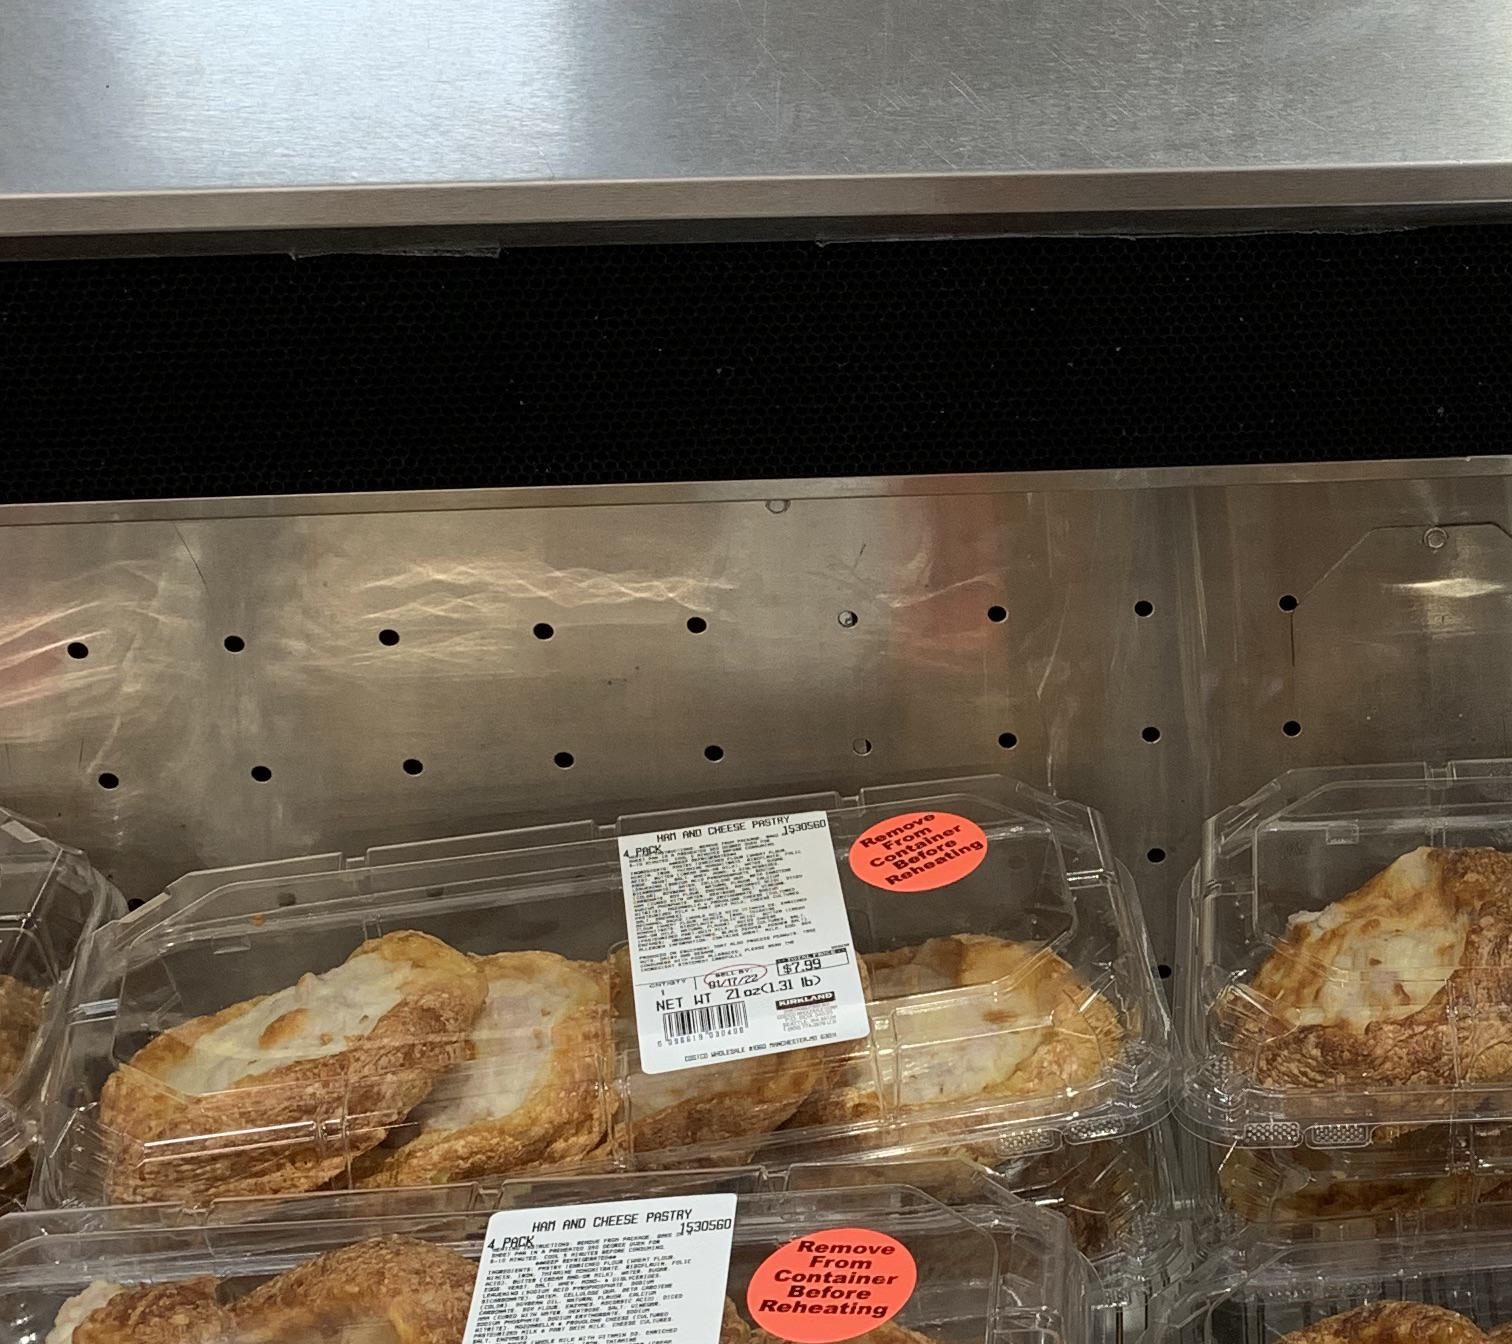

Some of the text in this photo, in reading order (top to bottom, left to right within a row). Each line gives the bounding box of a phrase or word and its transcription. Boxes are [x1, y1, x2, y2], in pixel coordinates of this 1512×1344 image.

[859, 814, 935, 847] Remove
[883, 826, 931, 851] From
[869, 823, 962, 867] Container
[892, 838, 956, 870] Before
[885, 840, 984, 886] Reheating
[532, 1209, 692, 1232] HAM AND CHEESE PASTRY
[680, 1219, 731, 1234] 1530560
[488, 1236, 534, 1250] 4 PACK
[798, 1240, 895, 1256] Remove
[808, 1255, 872, 1270] From
[774, 1269, 898, 1286] Container
[786, 1285, 871, 1301] Before
[759, 1299, 889, 1318] Reheating
